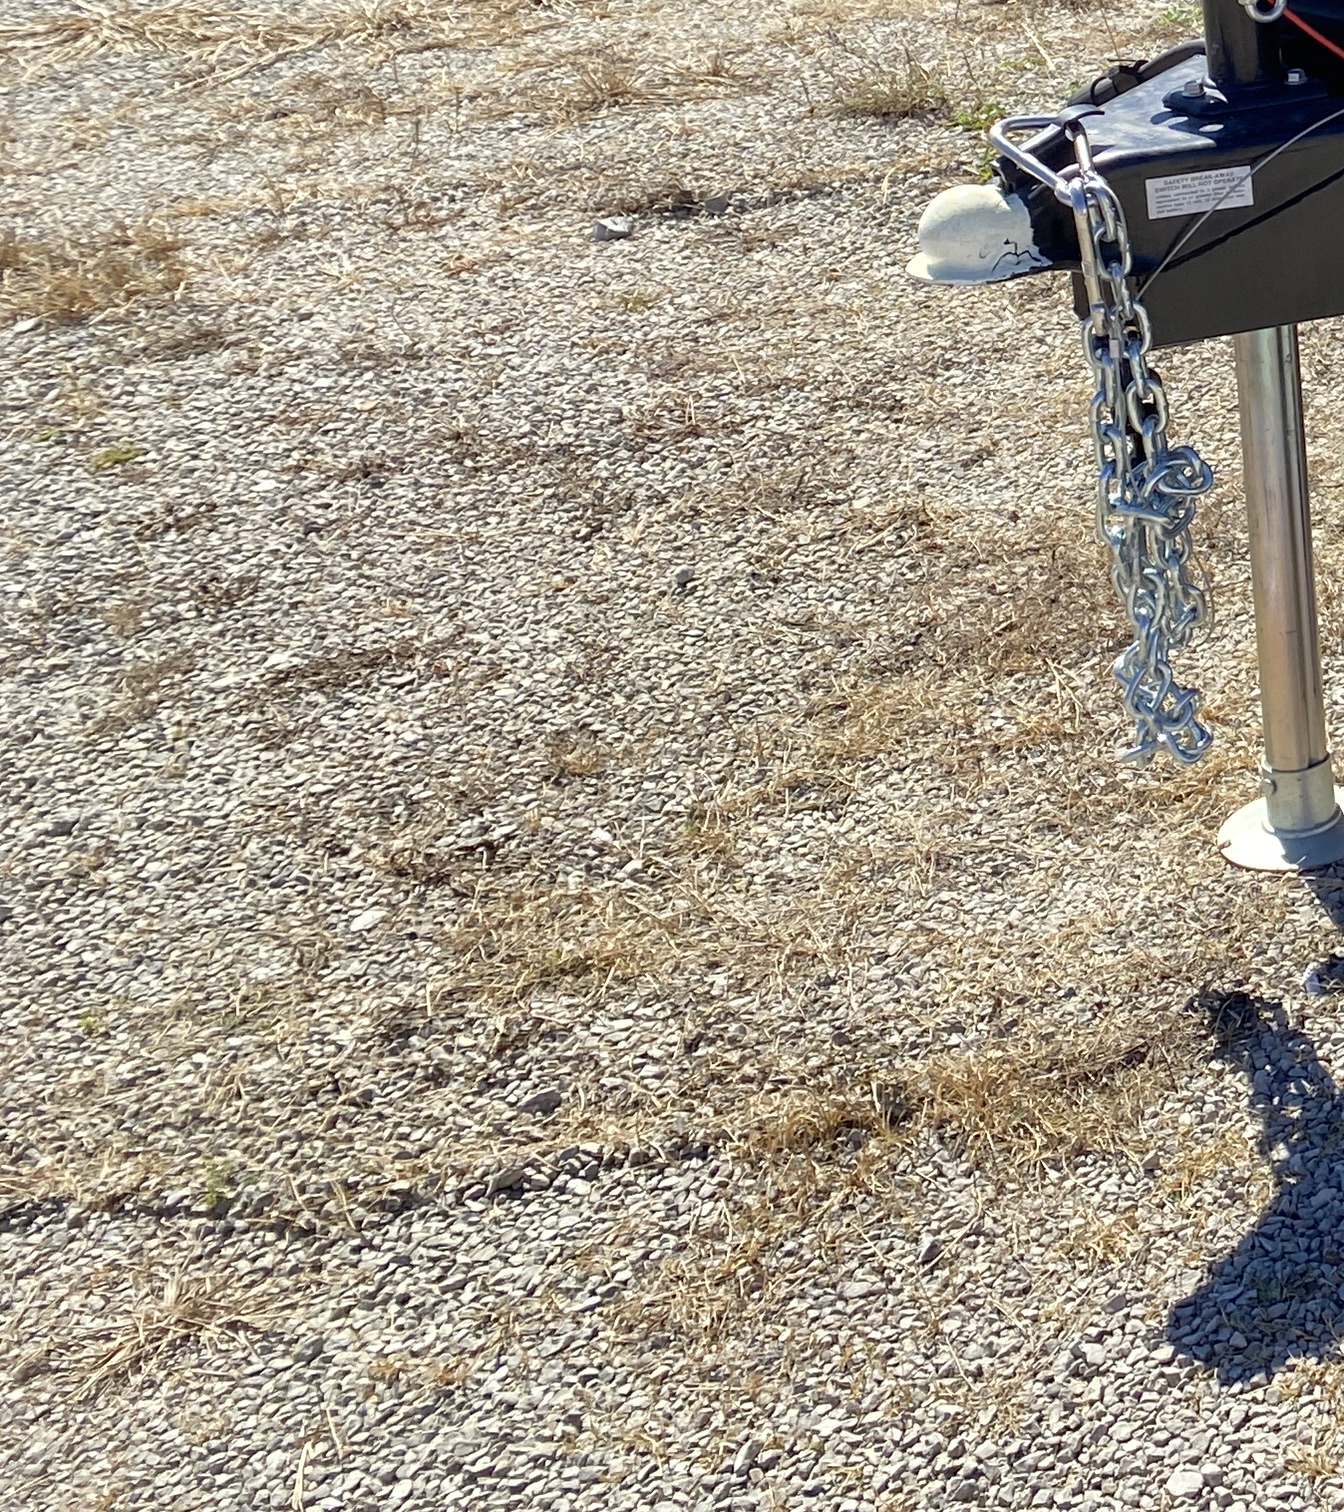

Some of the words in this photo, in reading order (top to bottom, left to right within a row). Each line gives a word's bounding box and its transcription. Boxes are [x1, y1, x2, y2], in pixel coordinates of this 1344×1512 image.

[1154, 185, 1181, 194] SWITCH
[1181, 183, 1198, 191] WILL
[1198, 180, 1212, 188] NOT
[1163, 176, 1190, 186] SAFETY
